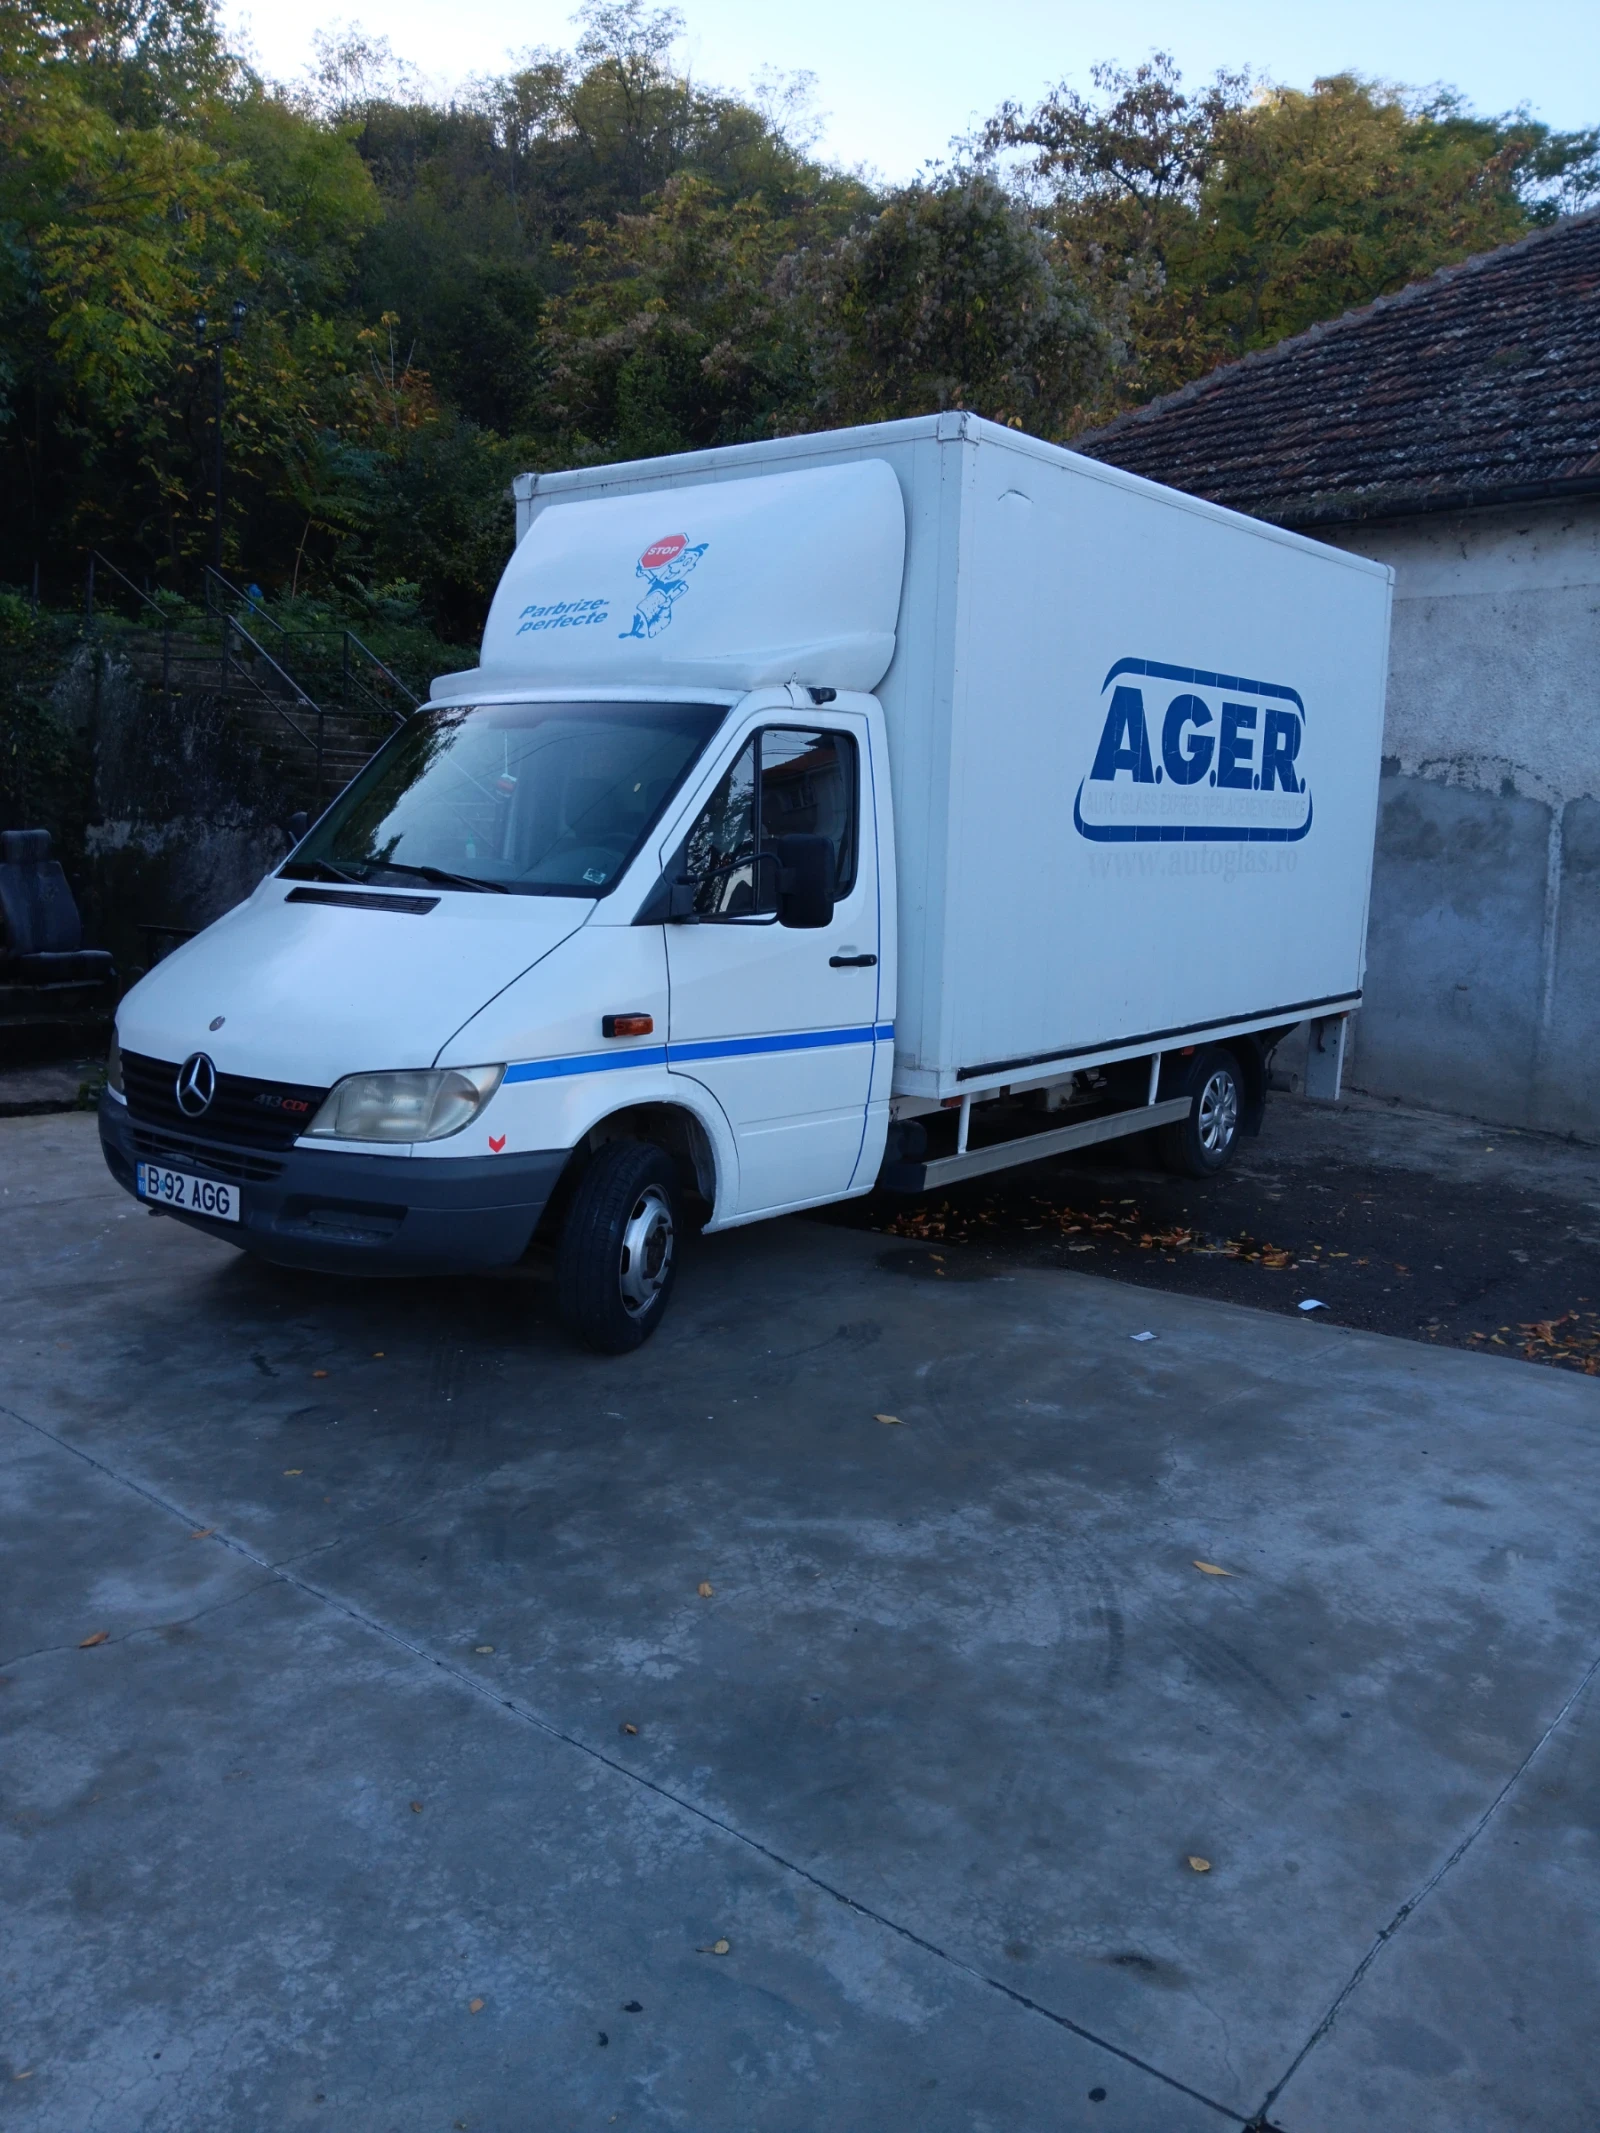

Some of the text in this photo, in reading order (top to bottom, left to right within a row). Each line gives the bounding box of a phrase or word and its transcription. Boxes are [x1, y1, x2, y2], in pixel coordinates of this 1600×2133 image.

[648, 546, 680, 556] STOP
[515, 612, 609, 636] perfecte
[1089, 685, 1306, 794] A.G.E.R.
[1085, 791, 1117, 815] AUTO
[1120, 792, 1157, 816] GLASS
[1087, 843, 1299, 884] www.autoglas.ro
[148, 1166, 230, 1215] B 92 AGG
